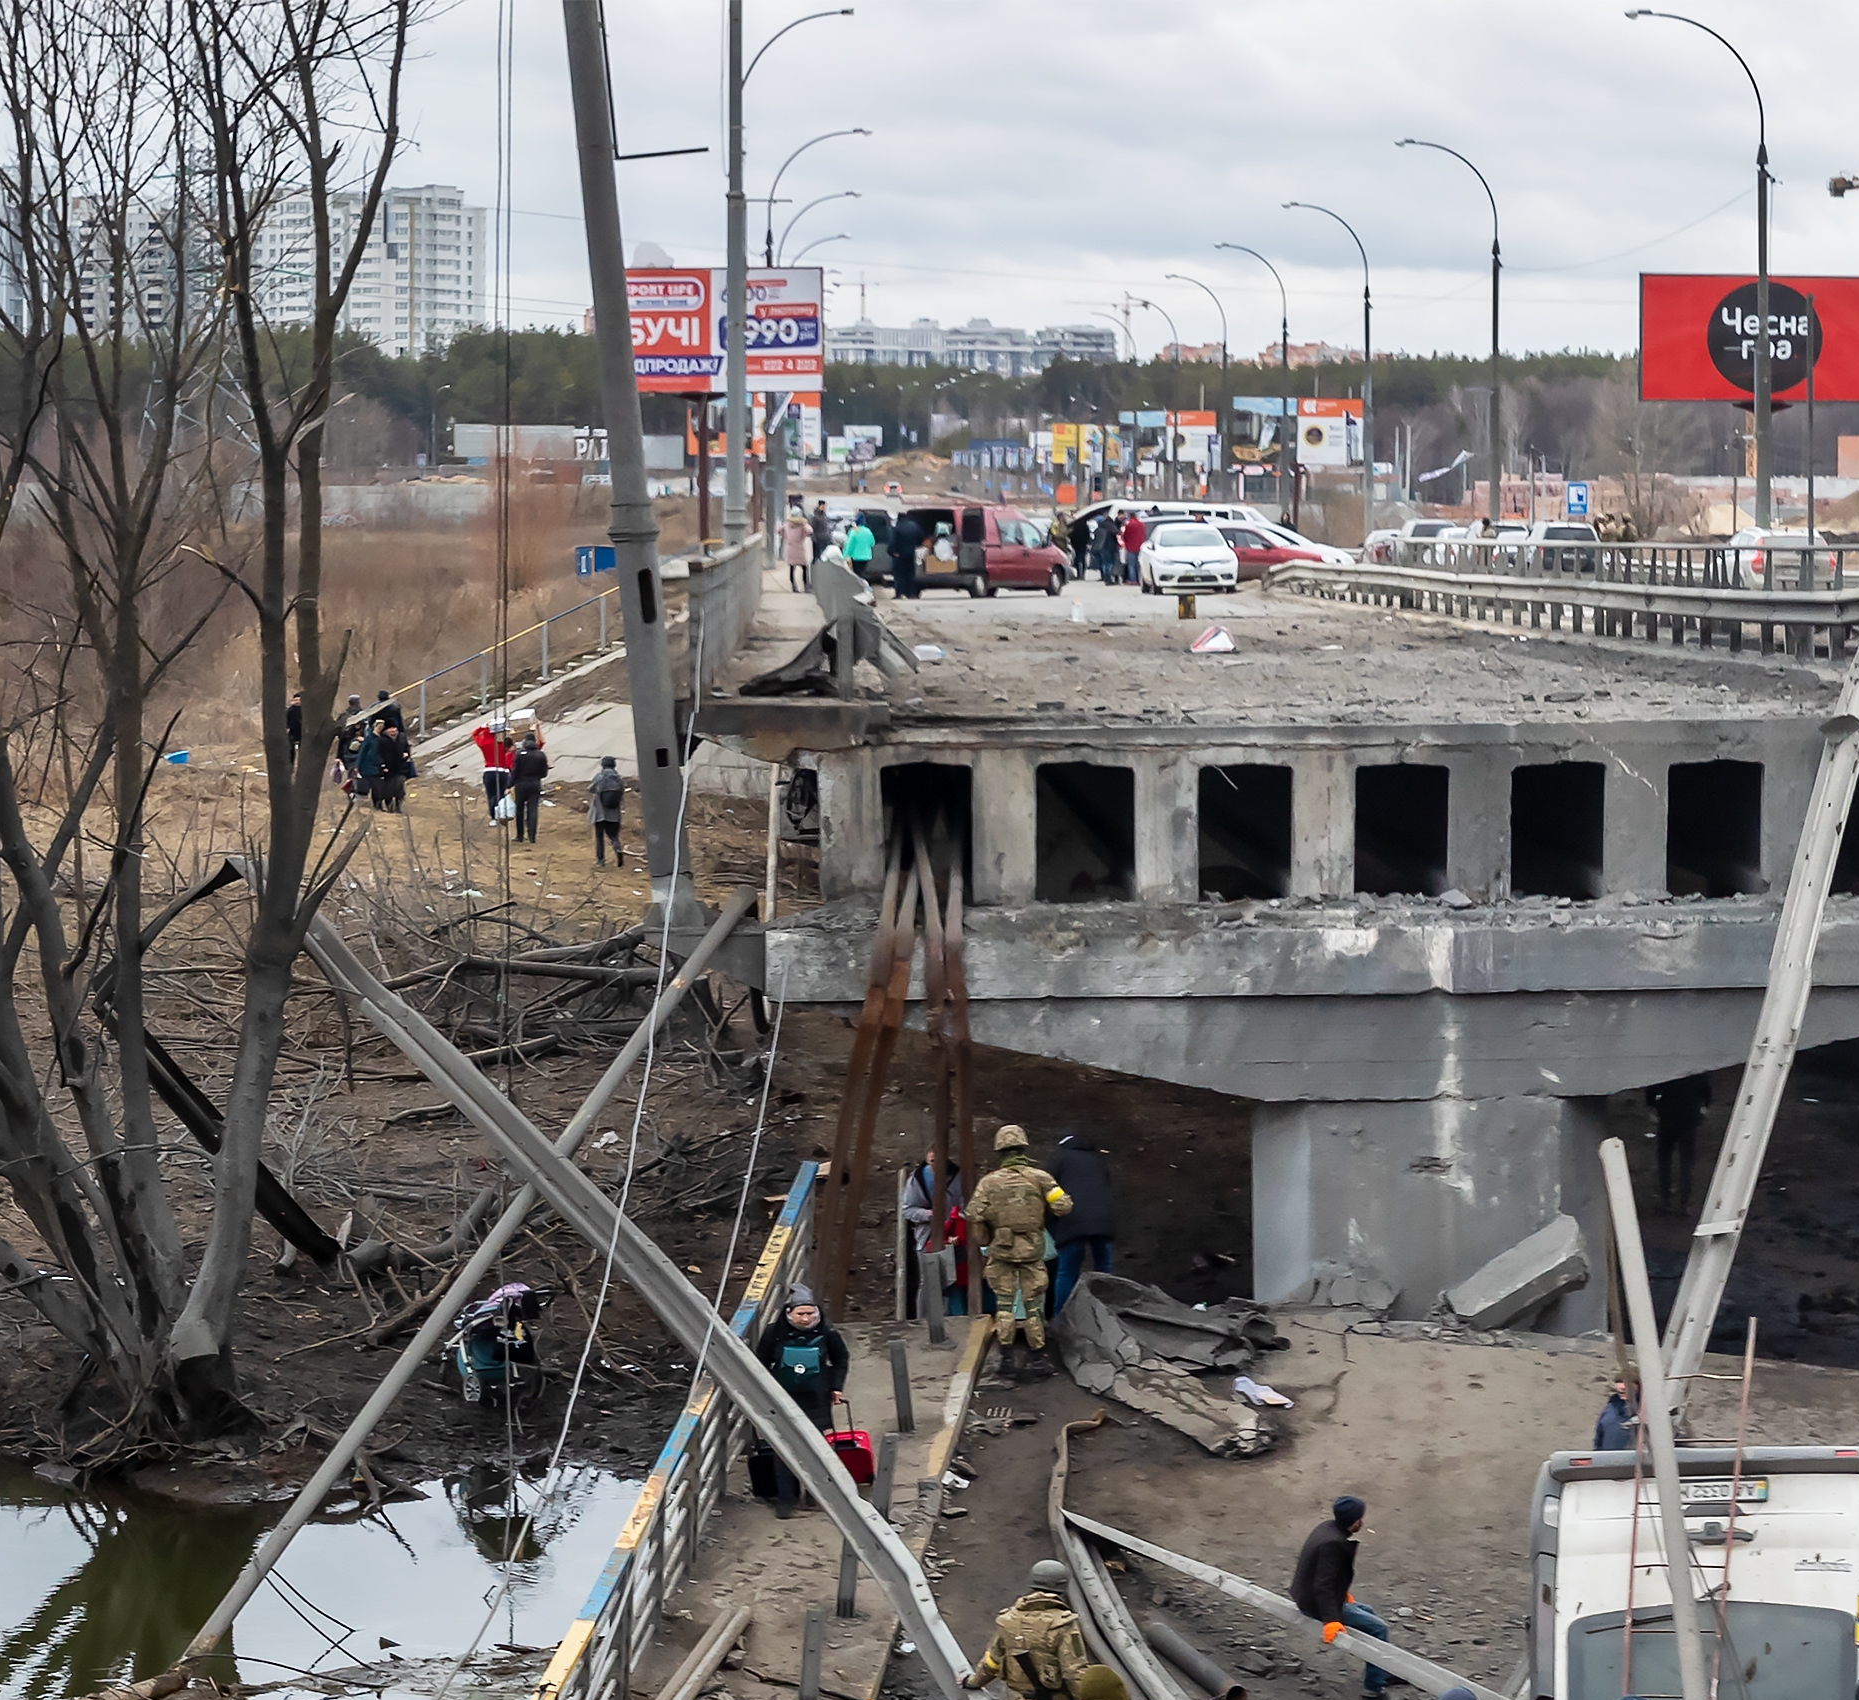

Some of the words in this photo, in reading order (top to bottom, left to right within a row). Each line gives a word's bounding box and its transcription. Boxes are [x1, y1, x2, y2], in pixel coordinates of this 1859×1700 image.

[627, 284, 665, 296] PORT
[725, 318, 799, 346] 990
[1721, 306, 1810, 336] Чесна
